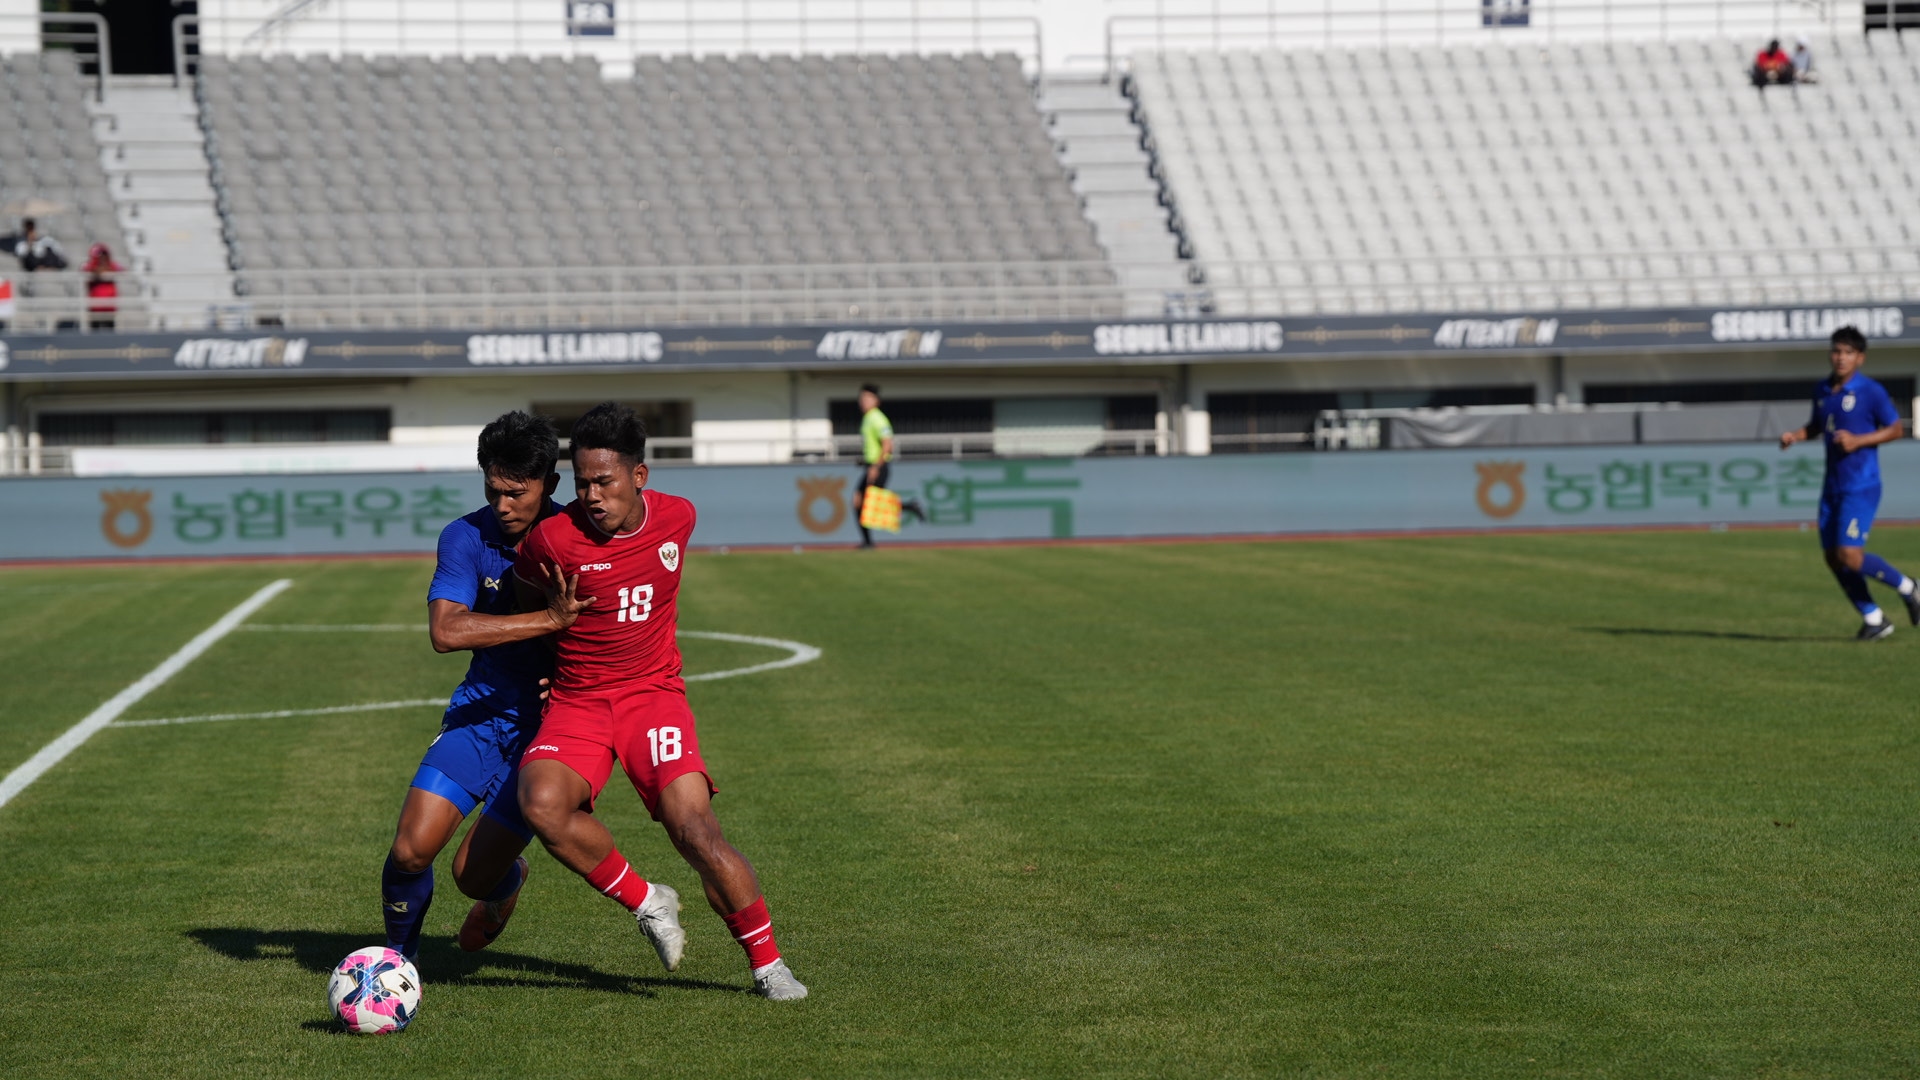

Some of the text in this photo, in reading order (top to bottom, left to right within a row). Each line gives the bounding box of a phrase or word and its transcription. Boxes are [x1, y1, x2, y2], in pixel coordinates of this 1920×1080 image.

[580, 562, 612, 571] erspo
[617, 583, 654, 623] 18
[646, 725, 682, 767] 18
